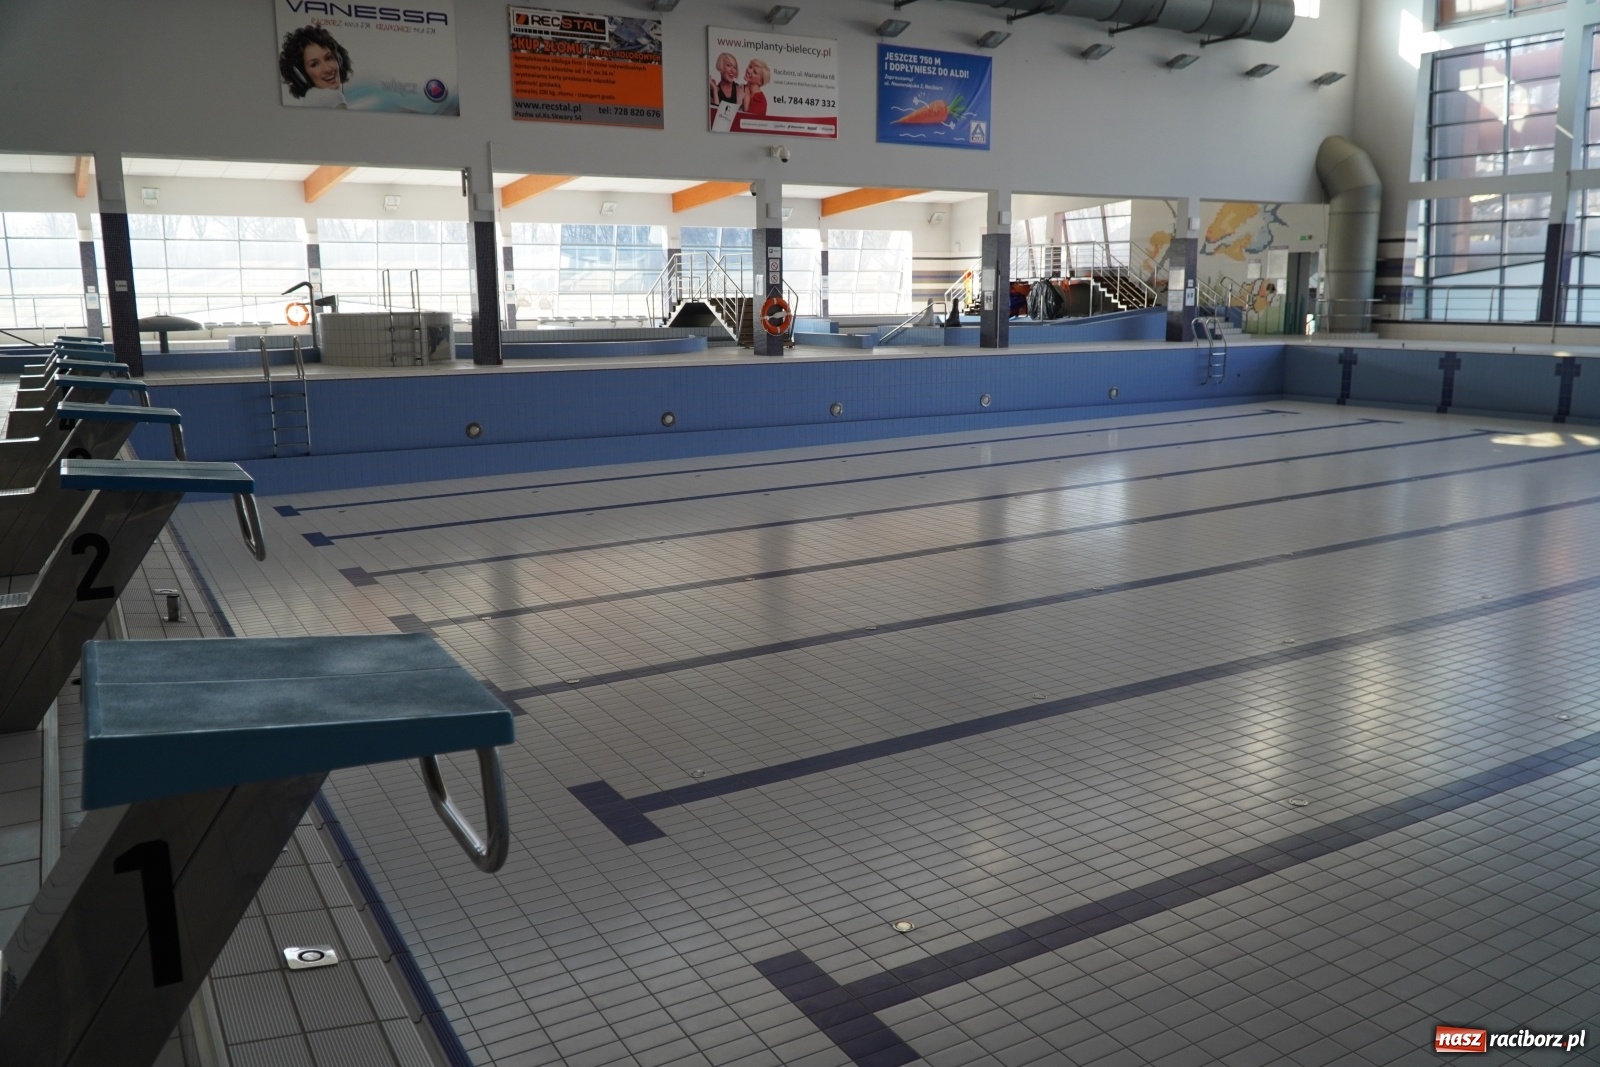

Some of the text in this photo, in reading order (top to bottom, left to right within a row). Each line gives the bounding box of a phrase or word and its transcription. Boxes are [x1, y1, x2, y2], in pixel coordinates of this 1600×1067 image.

[286, 0, 448, 26] VANESSA
[531, 15, 604, 32] RECSTAL
[512, 37, 540, 50] SKUP
[543, 40, 584, 55] ZŁOMU
[616, 51, 661, 61] KOLOROWYCH
[717, 38, 831, 58] www.implanty-bieleccy.pl
[884, 52, 941, 66] JESZCZE 750 M
[885, 61, 970, 79] I DOPŁYNIESZ DO ALDI!
[515, 100, 661, 118] www.recstal.pl tel: 728 820 676
[773, 95, 836, 108] tel. 784 487 332
[515, 110, 534, 118] Pszów
[71, 532, 115, 601] 2
[113, 838, 183, 988] 1
